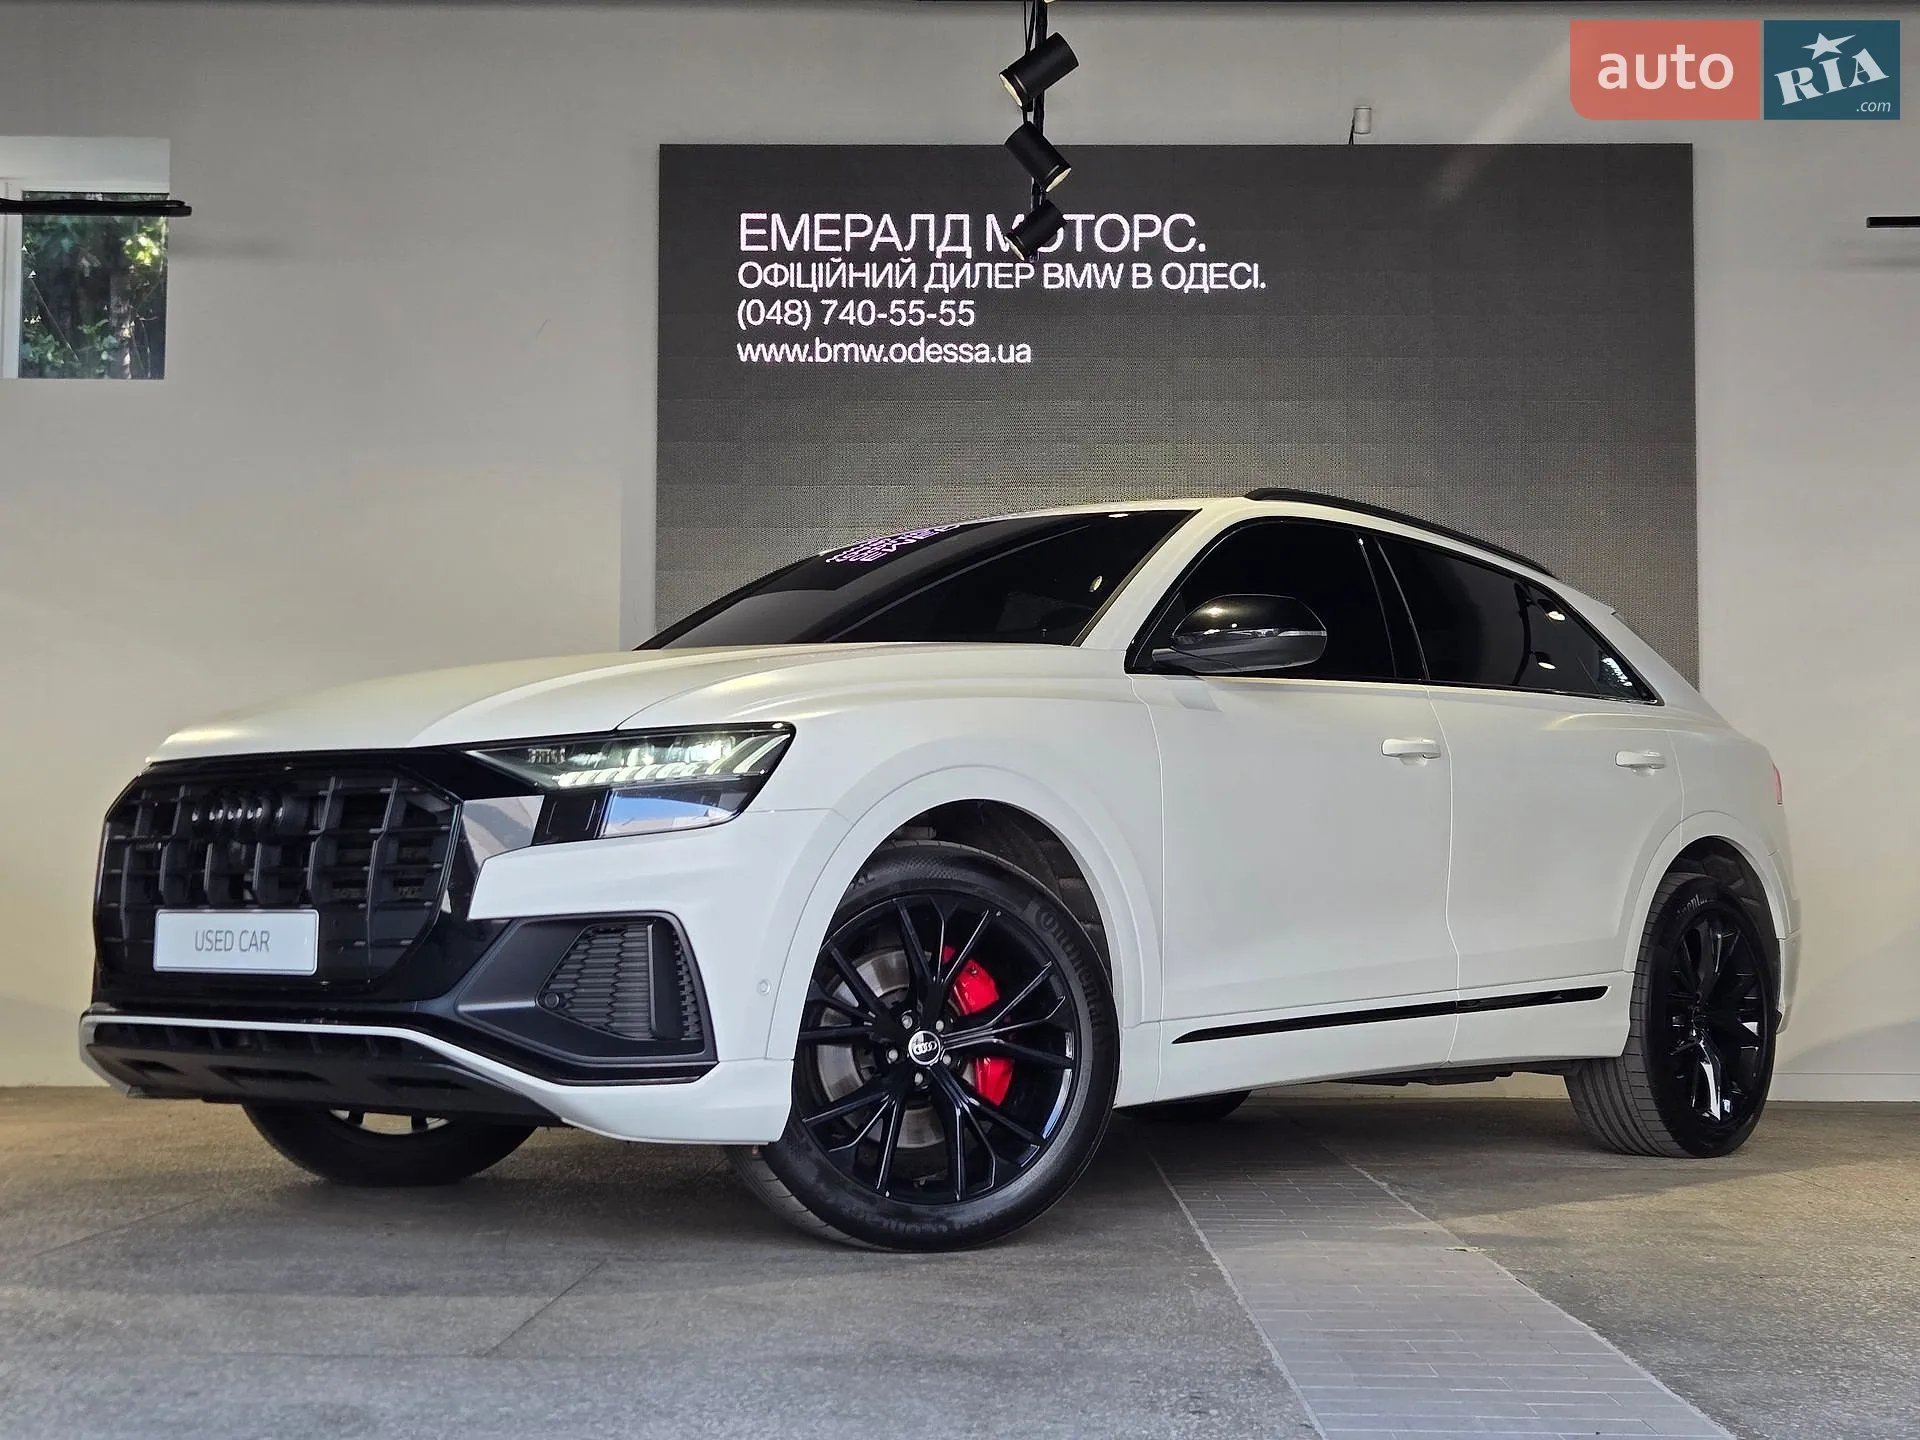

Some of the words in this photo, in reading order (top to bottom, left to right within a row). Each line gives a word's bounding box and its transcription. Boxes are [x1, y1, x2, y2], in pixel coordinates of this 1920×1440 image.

[740, 213, 973, 259] ЕМЕРАЛД
[737, 257, 917, 293] ОФІЦІЙНИЙ
[923, 262, 1036, 294] ДИЛЕР
[1043, 262, 1125, 290] BMW
[1131, 262, 1154, 290] В
[1161, 262, 1267, 294] ОДЕСІ.
[737, 299, 812, 331] (048)
[820, 299, 975, 327] 740-55-55
[736, 336, 1032, 368] www.bmw.odessa.ua
[194, 929, 235, 952] USED
[238, 929, 271, 953] CAR
